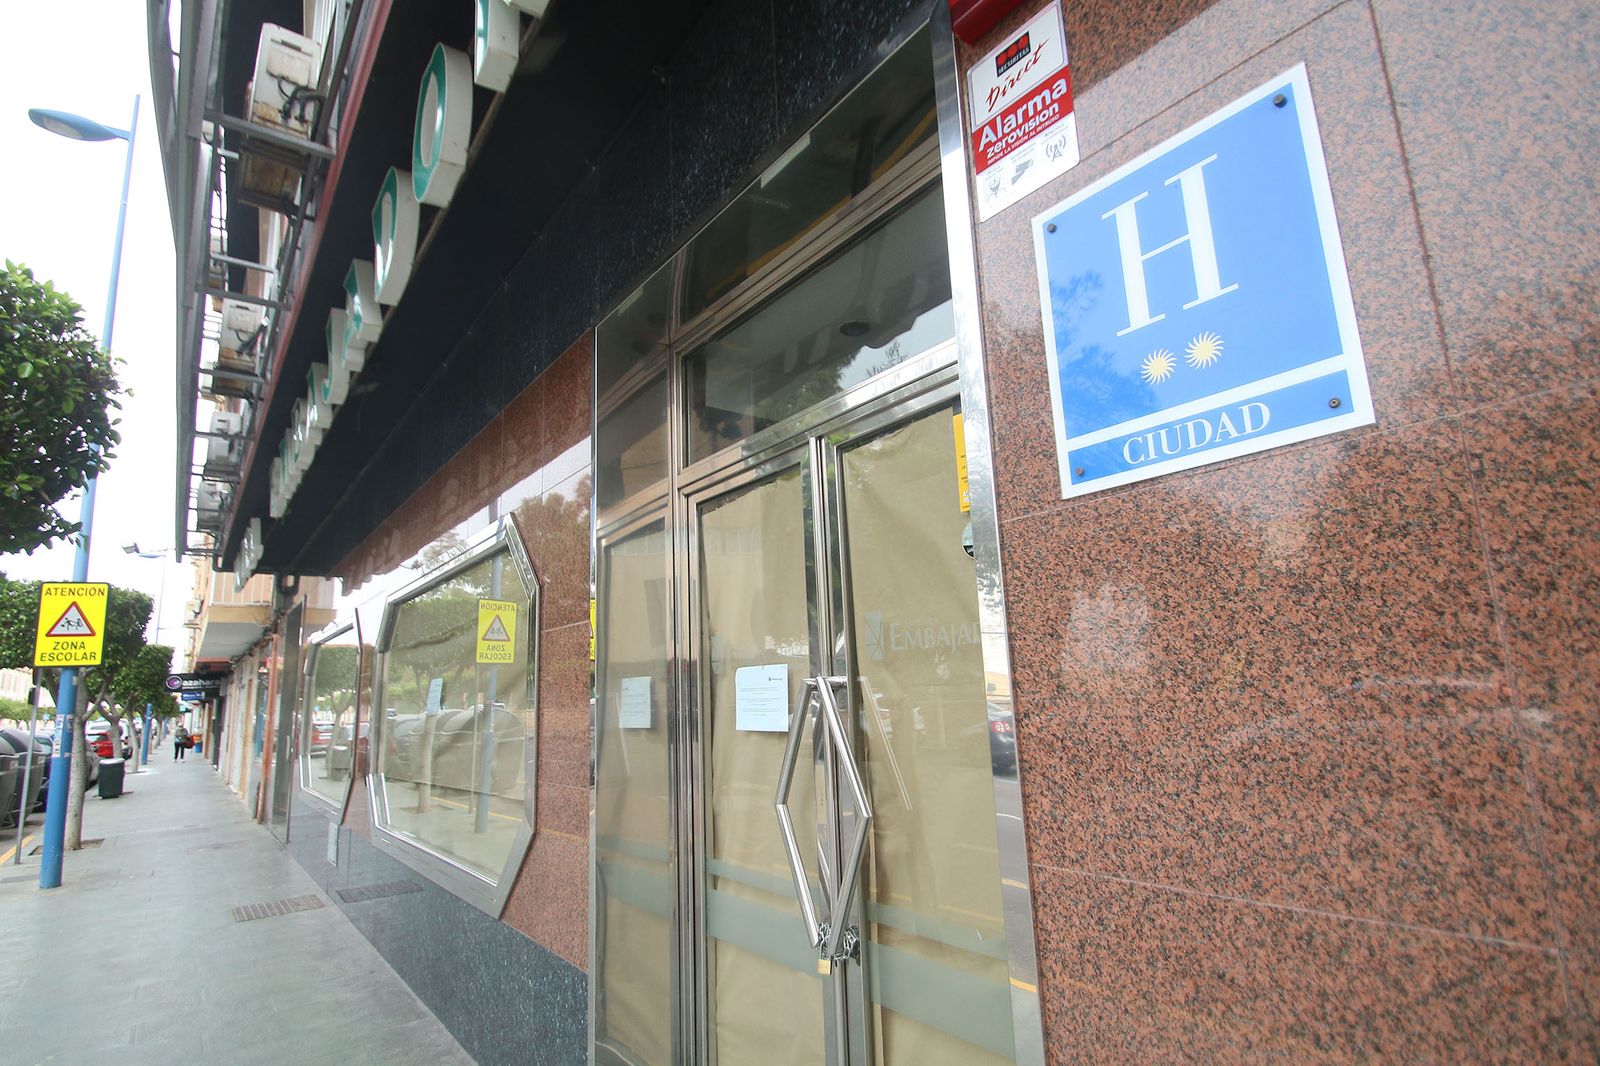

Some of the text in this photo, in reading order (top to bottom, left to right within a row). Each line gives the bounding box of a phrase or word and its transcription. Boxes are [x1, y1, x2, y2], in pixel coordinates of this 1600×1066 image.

[985, 38, 1050, 112] Direct
[978, 78, 1068, 152] Alarma
[986, 103, 1059, 159] zerovision
[1102, 153, 1239, 337] H
[1122, 402, 1271, 465] CIUDAD
[40, 652, 97, 662] ESCOLAR
[53, 641, 86, 651] ZONA
